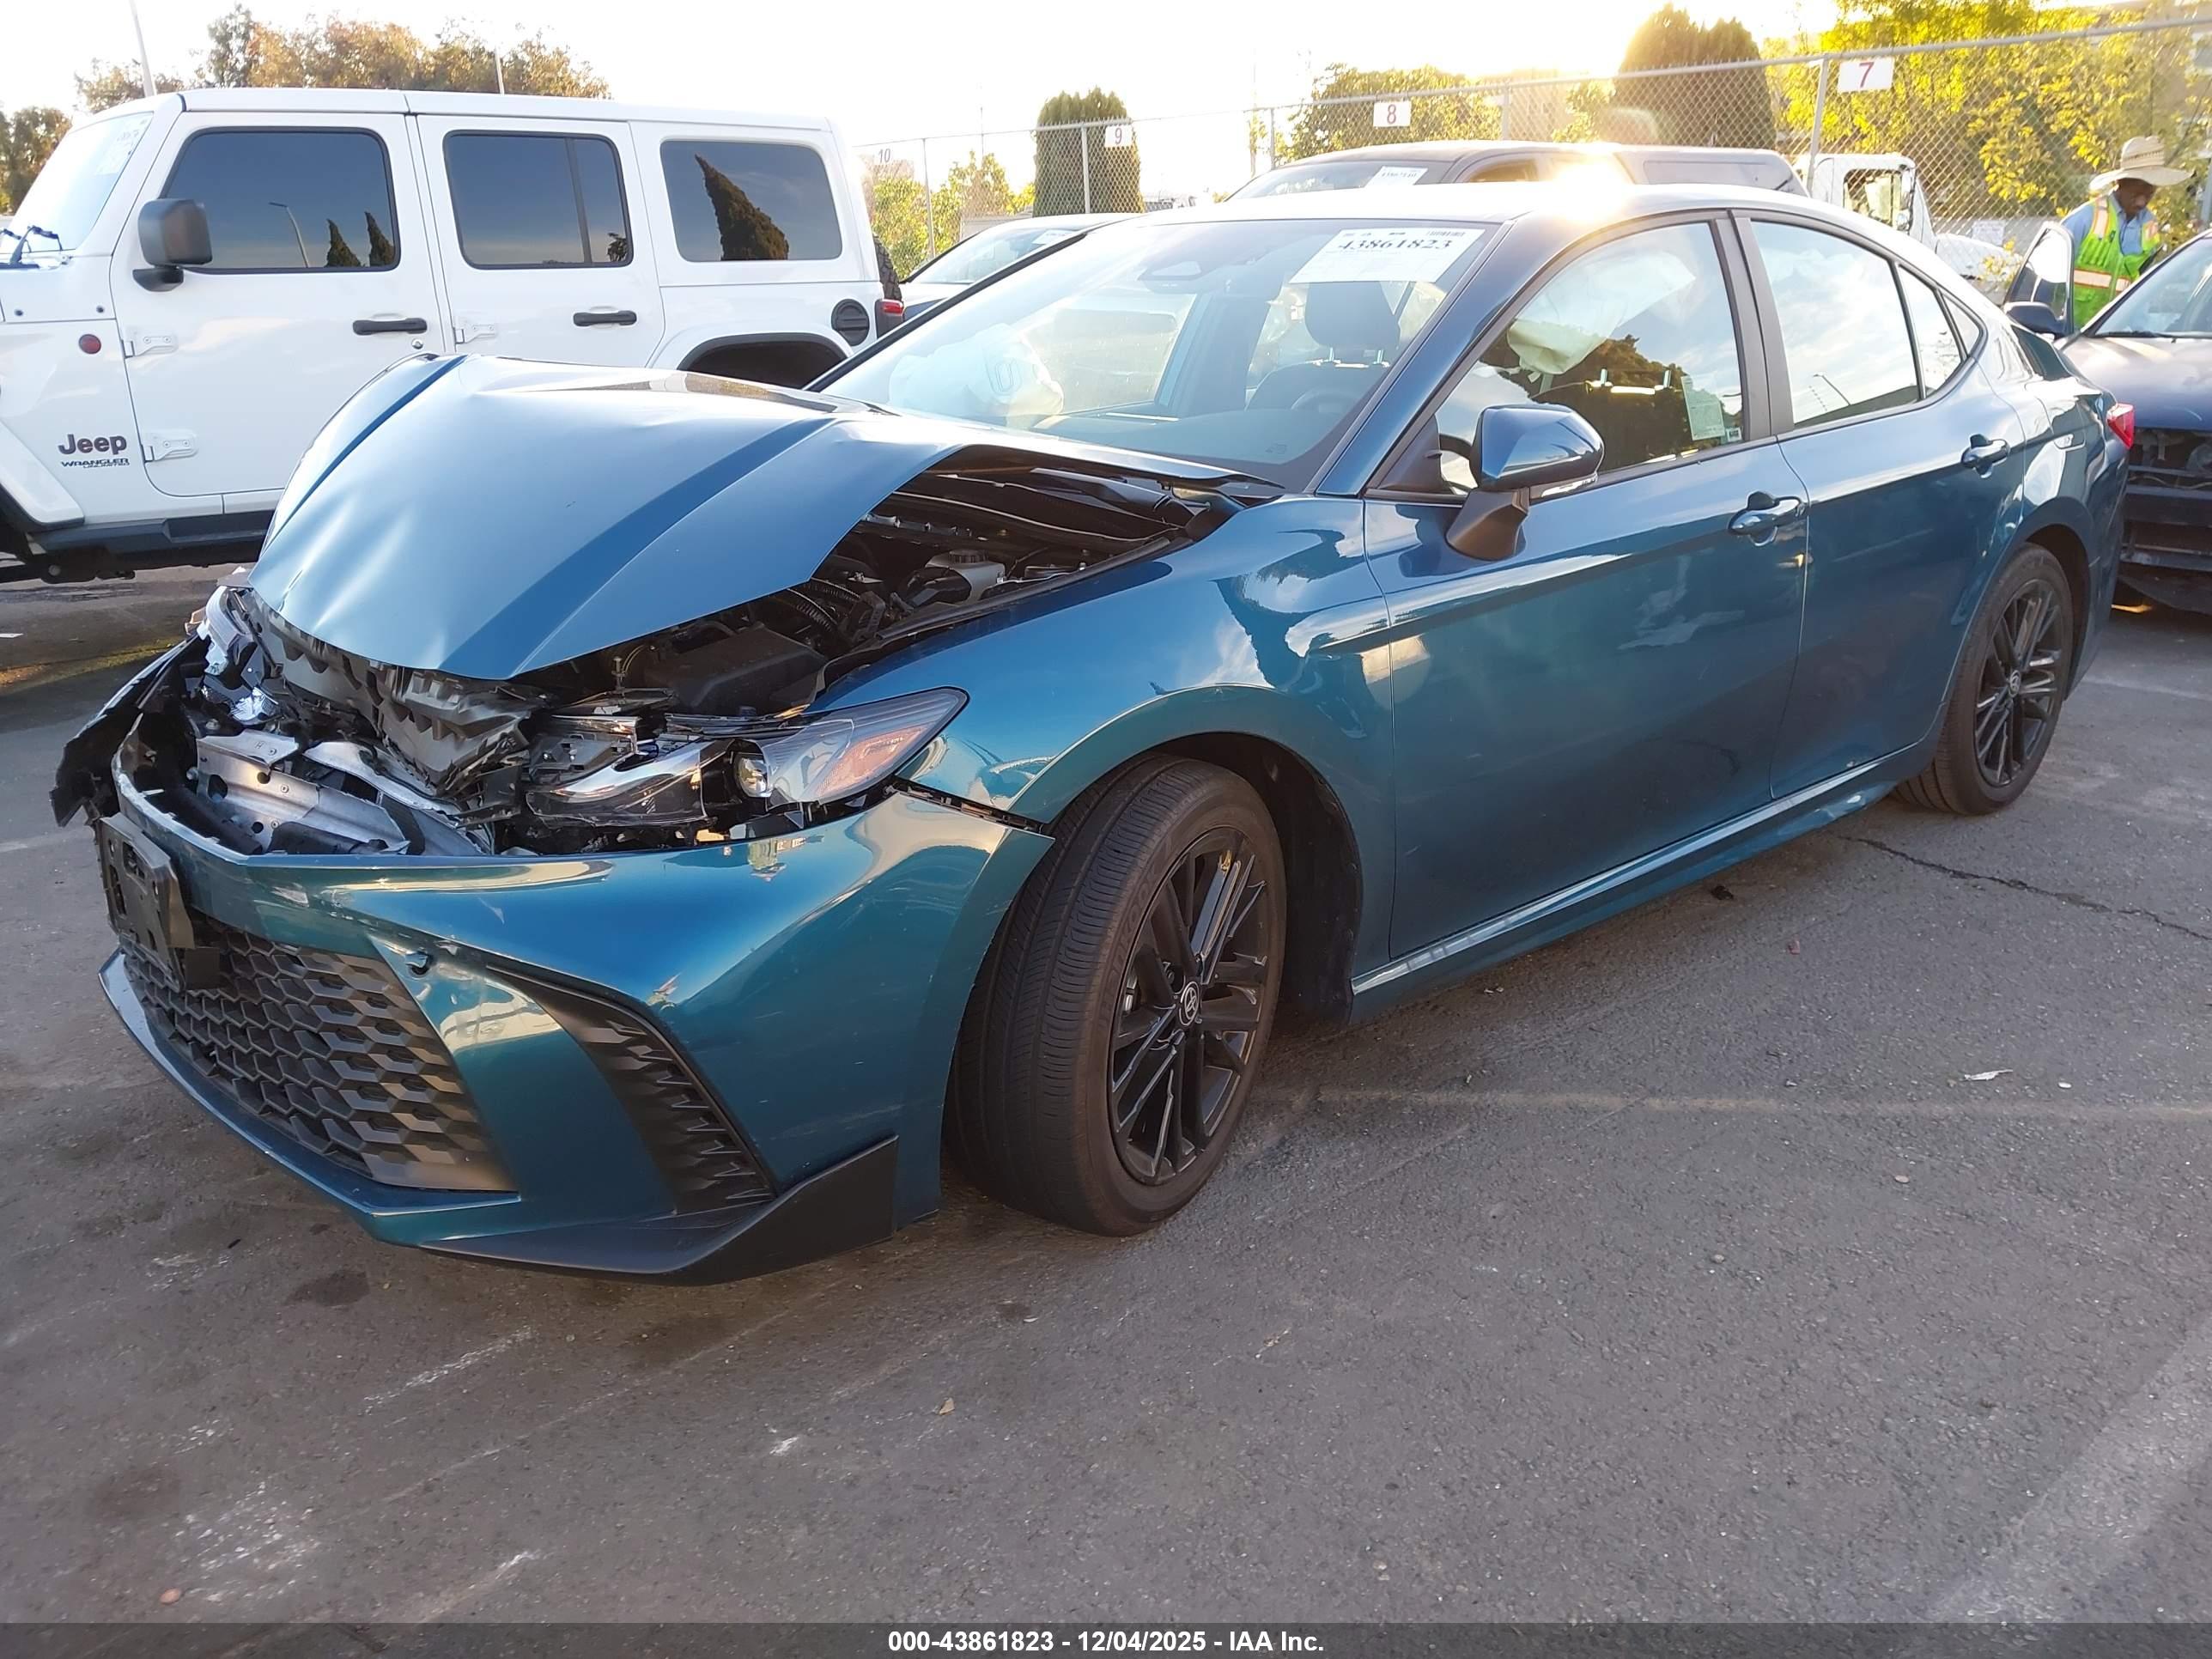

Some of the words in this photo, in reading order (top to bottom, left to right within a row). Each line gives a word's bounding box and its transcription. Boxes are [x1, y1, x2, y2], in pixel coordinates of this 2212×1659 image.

[1858, 61, 1875, 88] 7
[1386, 104, 1398, 125] 8
[1115, 127, 1122, 145] 9
[878, 148, 891, 164] 10
[1338, 239, 1453, 250] 43861823
[58, 434, 127, 455] Jeep
[61, 458, 129, 467] WRANGLER
